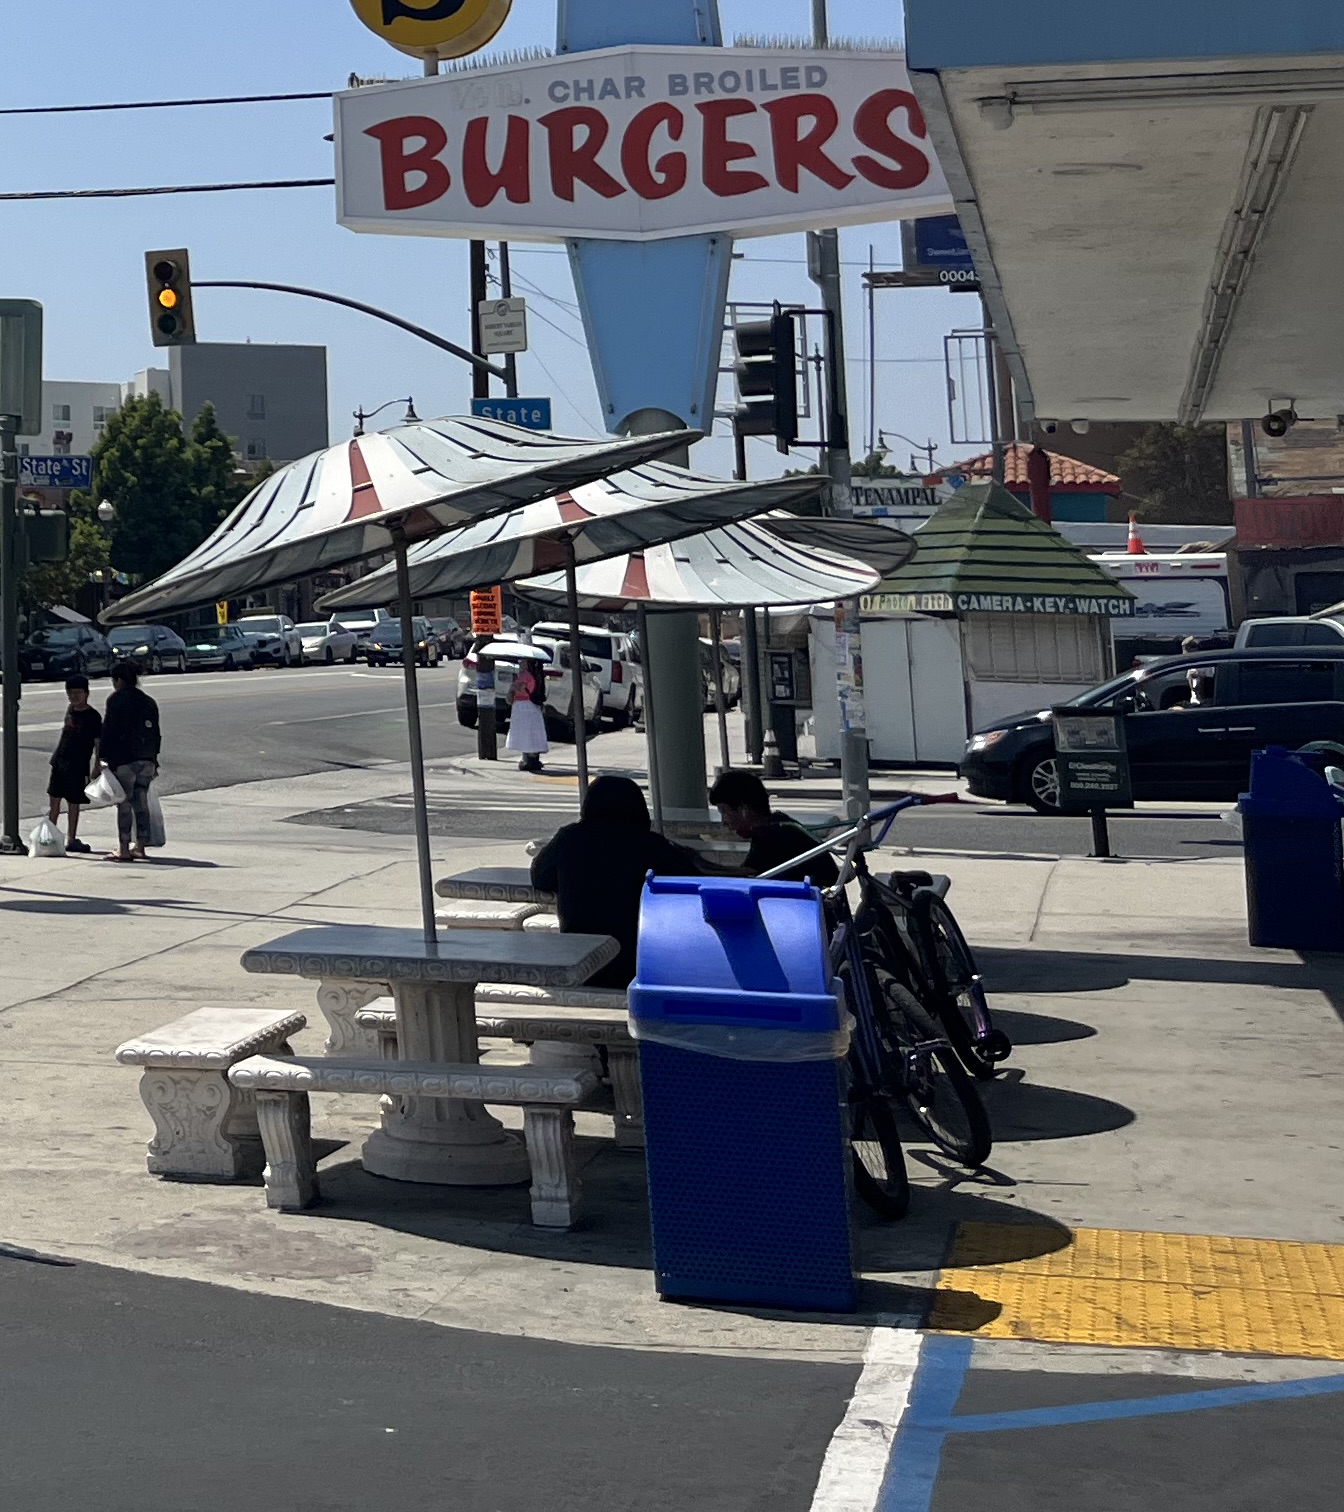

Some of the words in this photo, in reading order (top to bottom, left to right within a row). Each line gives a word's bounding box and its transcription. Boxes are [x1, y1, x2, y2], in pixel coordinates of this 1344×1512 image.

[547, 75, 647, 103] CHAR
[666, 64, 828, 97] BROILED
[362, 88, 931, 211] BURGERS
[939, 270, 981, 282] 0004
[481, 406, 541, 424] State
[21, 457, 62, 475] State
[71, 458, 88, 476] St
[957, 594, 1026, 612] CAMERA
[1032, 596, 1065, 613] KEY
[1075, 598, 1130, 615] WATCH
